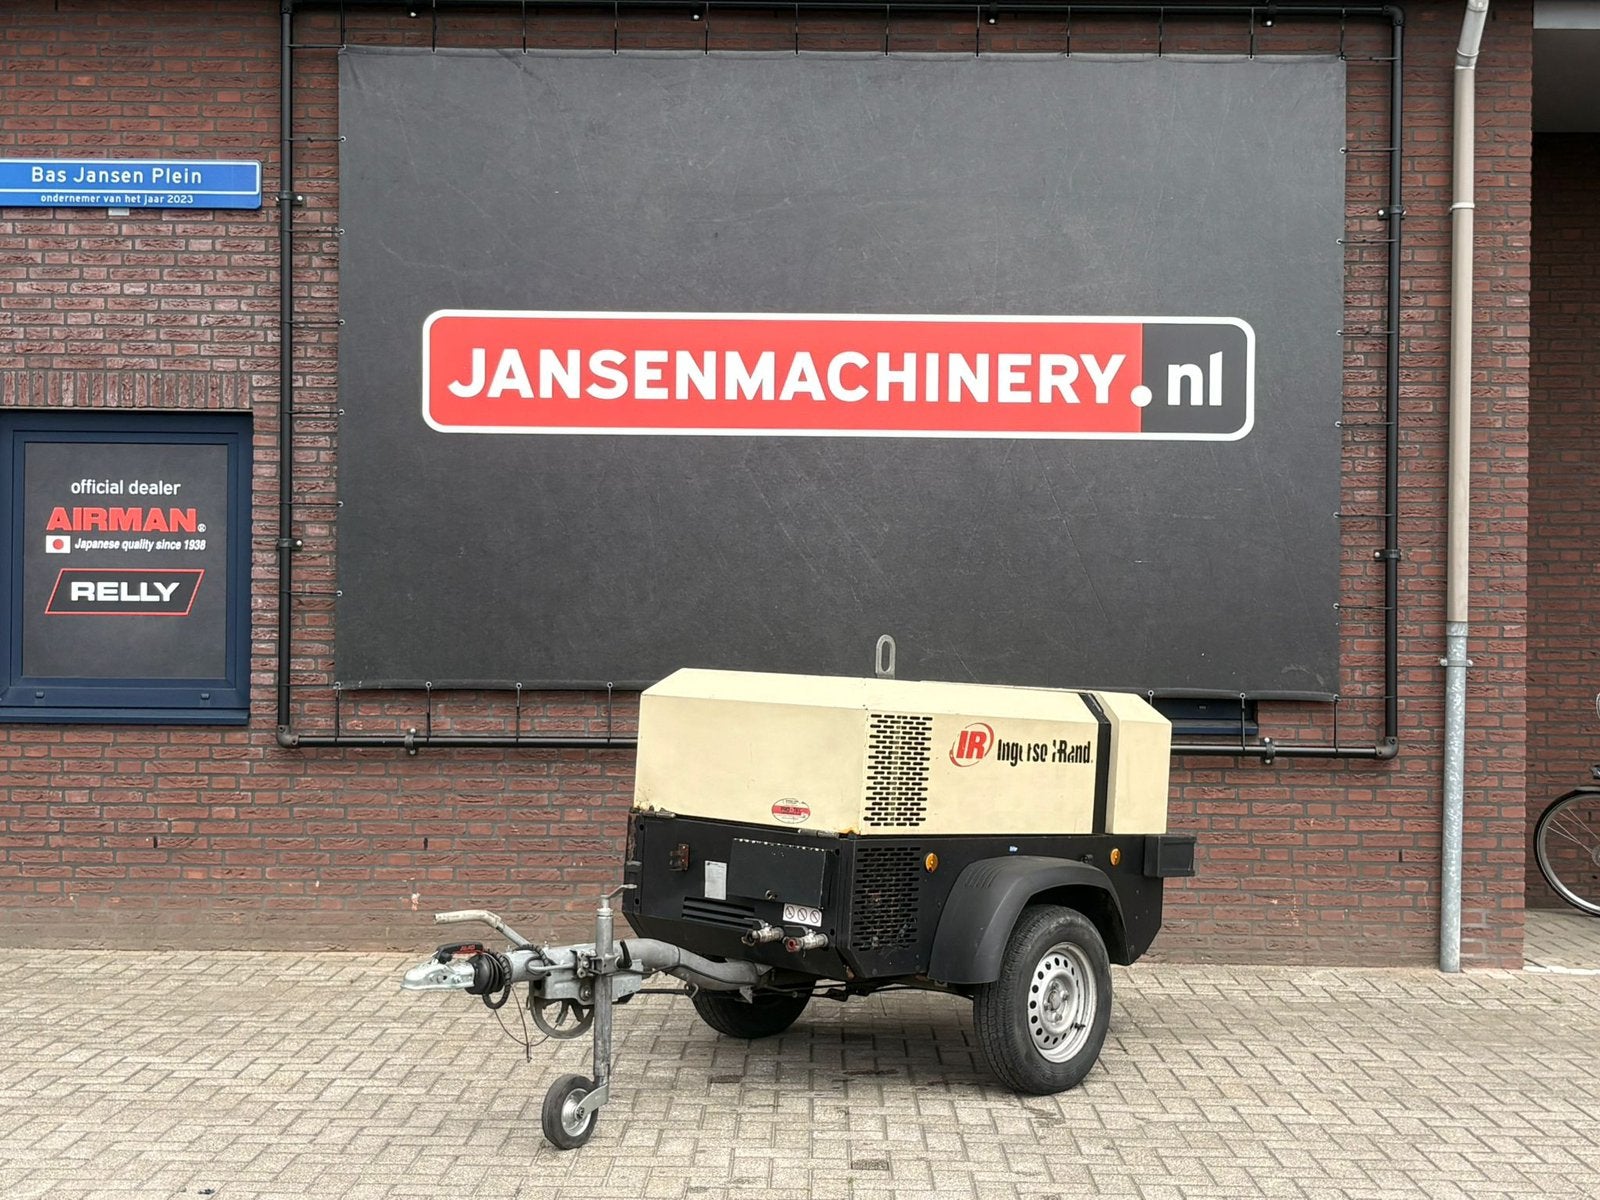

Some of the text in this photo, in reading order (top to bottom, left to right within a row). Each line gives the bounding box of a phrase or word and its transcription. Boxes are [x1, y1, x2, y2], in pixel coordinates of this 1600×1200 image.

[31, 166, 202, 183] Bas Jansen Plein
[40, 194, 100, 203] ondernemer
[125, 195, 141, 204] het
[143, 195, 164, 206] jaar
[167, 195, 194, 204] 2023
[447, 347, 1223, 408] JANSENMACHINERY.nl
[71, 479, 181, 495] official dealer
[74, 538, 206, 552] Japanese quality since 1938
[71, 581, 180, 602] RELLY
[956, 730, 987, 759] IR
